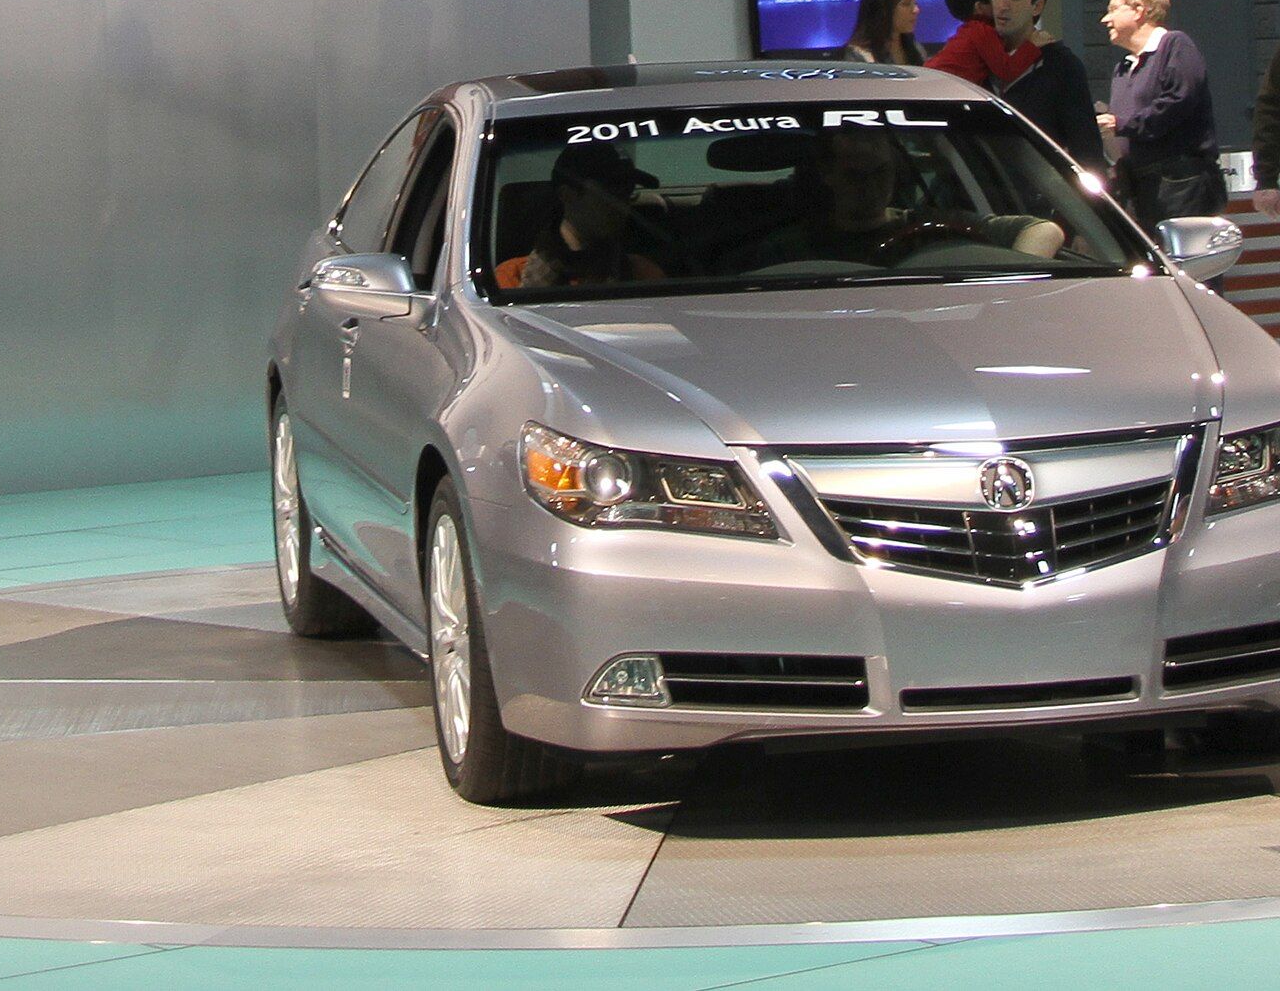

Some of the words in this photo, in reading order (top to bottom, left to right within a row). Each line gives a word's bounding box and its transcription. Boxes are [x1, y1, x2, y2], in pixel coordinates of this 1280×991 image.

[567, 119, 659, 144] 2011
[682, 115, 801, 134] Acura
[822, 109, 948, 127] RL
